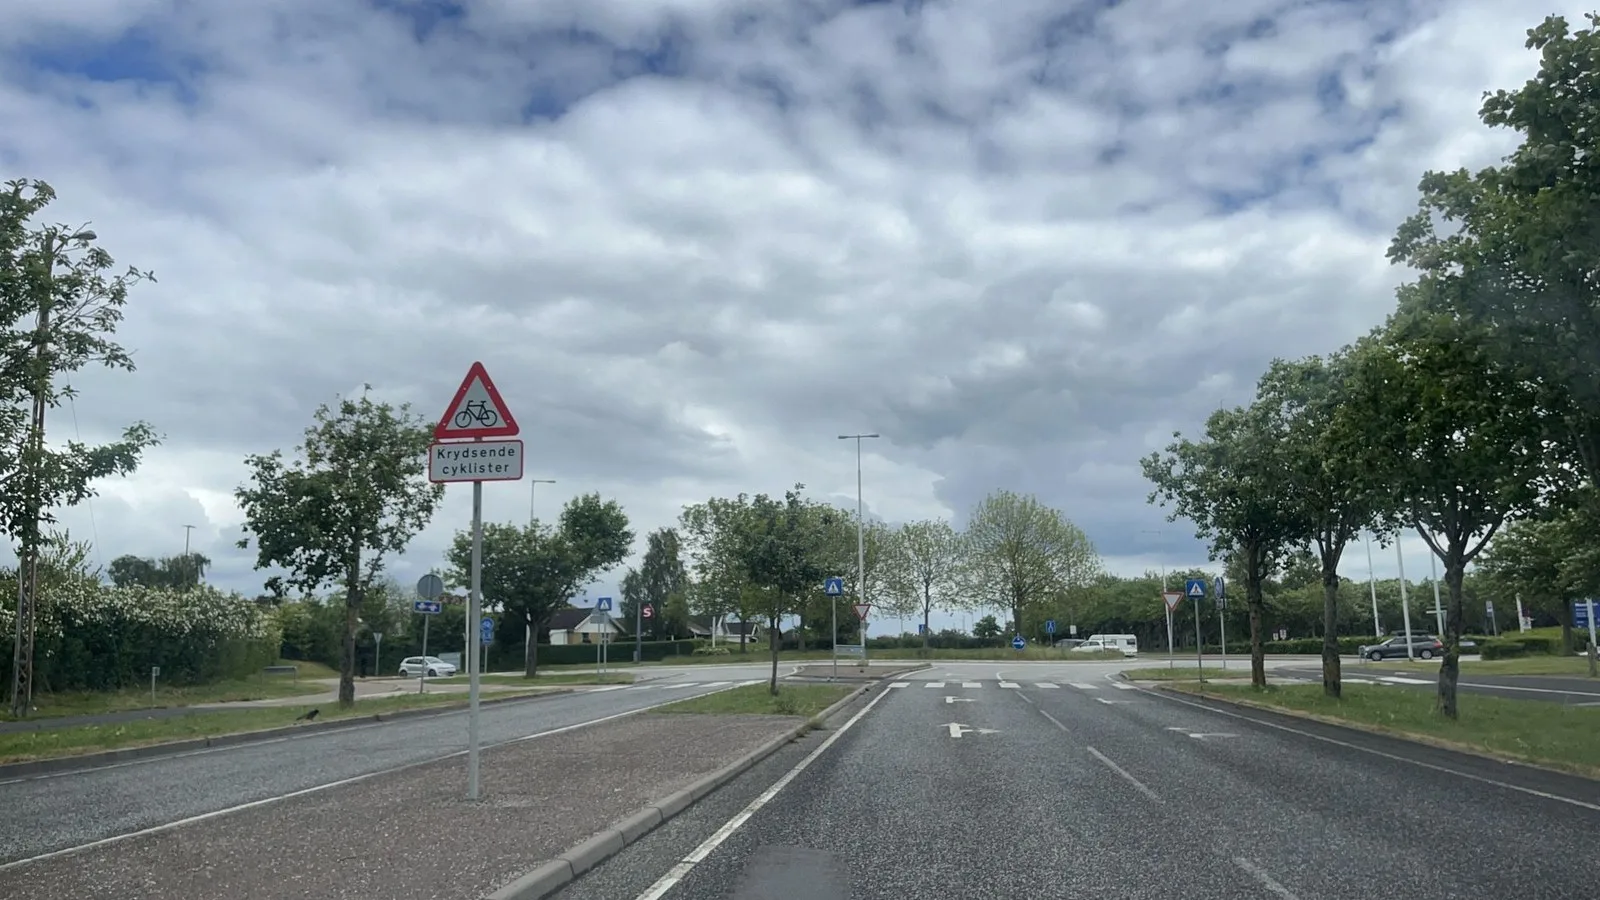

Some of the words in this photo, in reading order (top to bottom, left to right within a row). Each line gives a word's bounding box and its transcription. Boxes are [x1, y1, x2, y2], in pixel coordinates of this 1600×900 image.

[437, 446, 515, 460] Krydsende
[442, 462, 509, 476] cyklister
[643, 607, 651, 617] S
